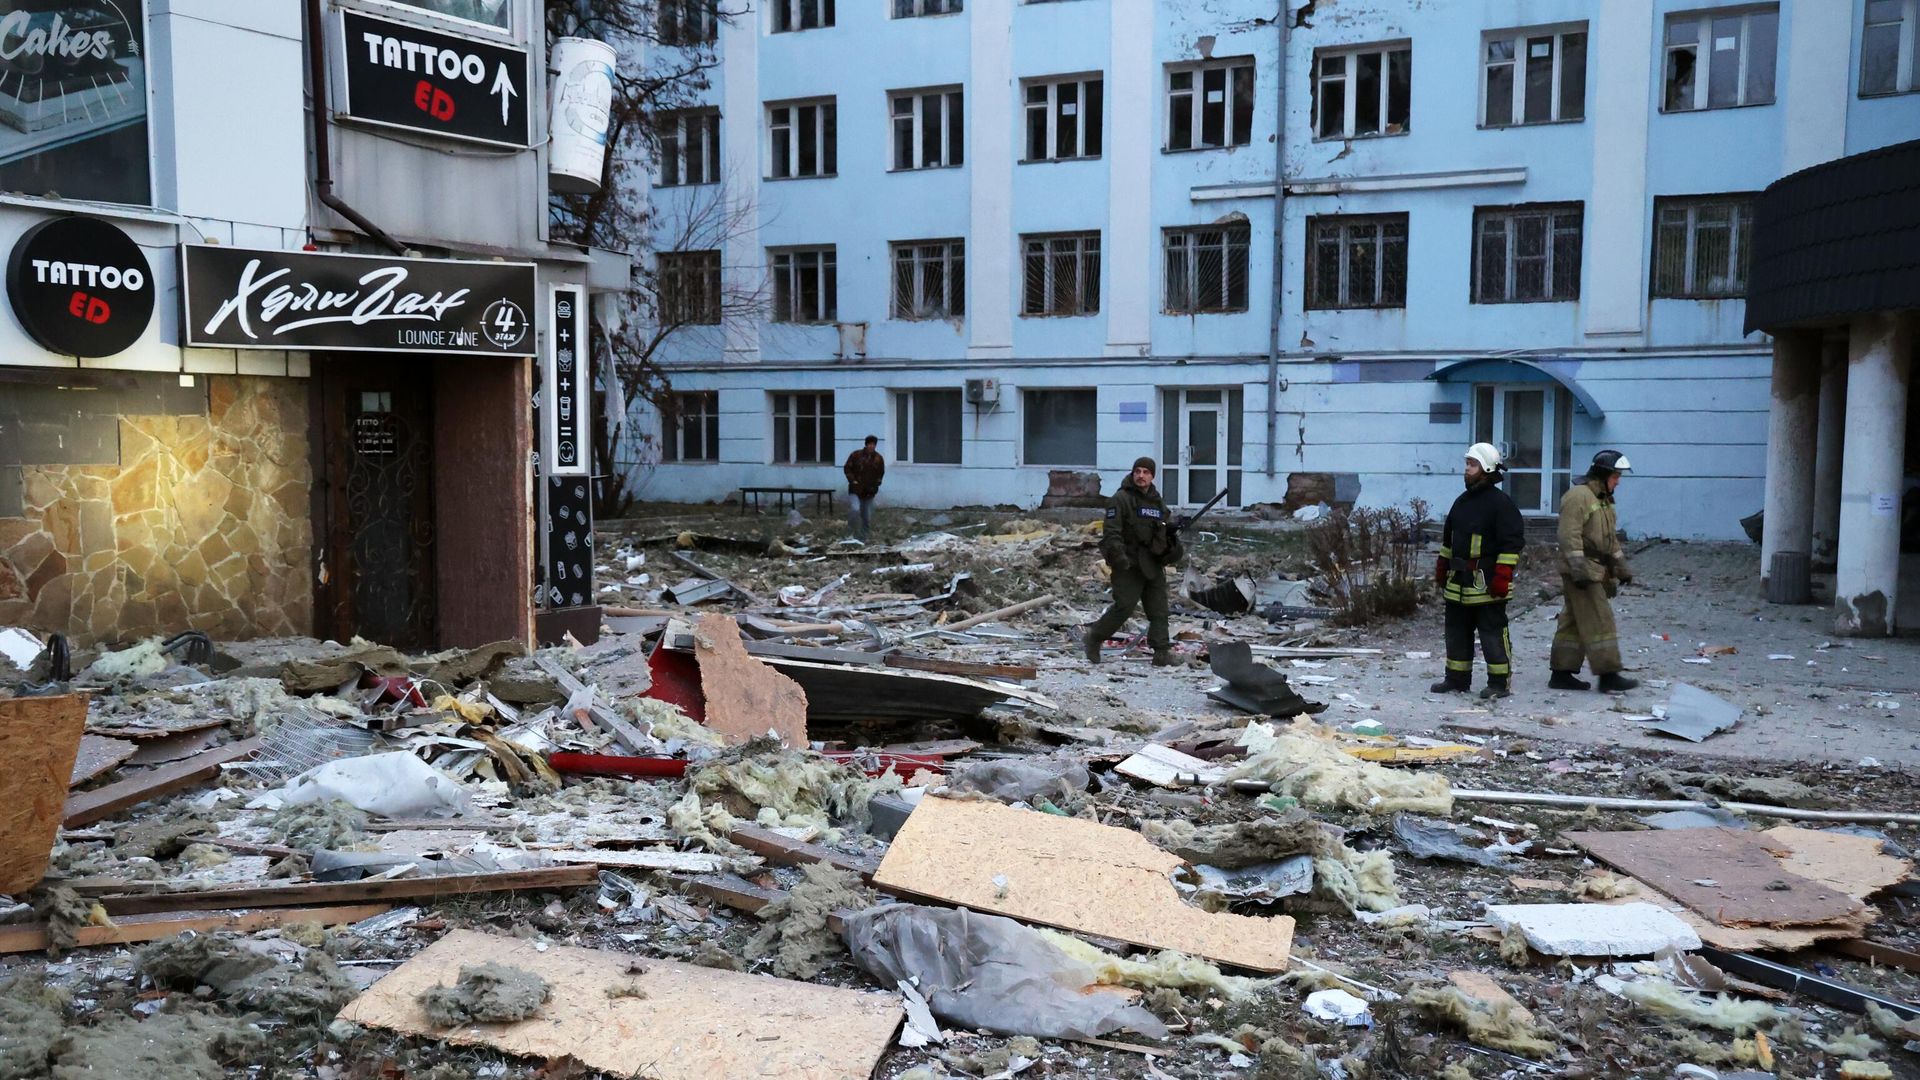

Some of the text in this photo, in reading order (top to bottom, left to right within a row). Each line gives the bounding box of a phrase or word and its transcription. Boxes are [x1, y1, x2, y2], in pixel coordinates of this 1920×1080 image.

[0, 9, 115, 60] Cakes
[363, 33, 486, 85] TATTOO
[414, 80, 456, 122] ED
[32, 258, 144, 291] TATTOO
[68, 291, 111, 325] ED
[494, 306, 516, 333] 4
[398, 329, 446, 345] LOUNGE
[494, 332, 516, 341] ЭТАЖ
[1140, 507, 1161, 518] PRESS
